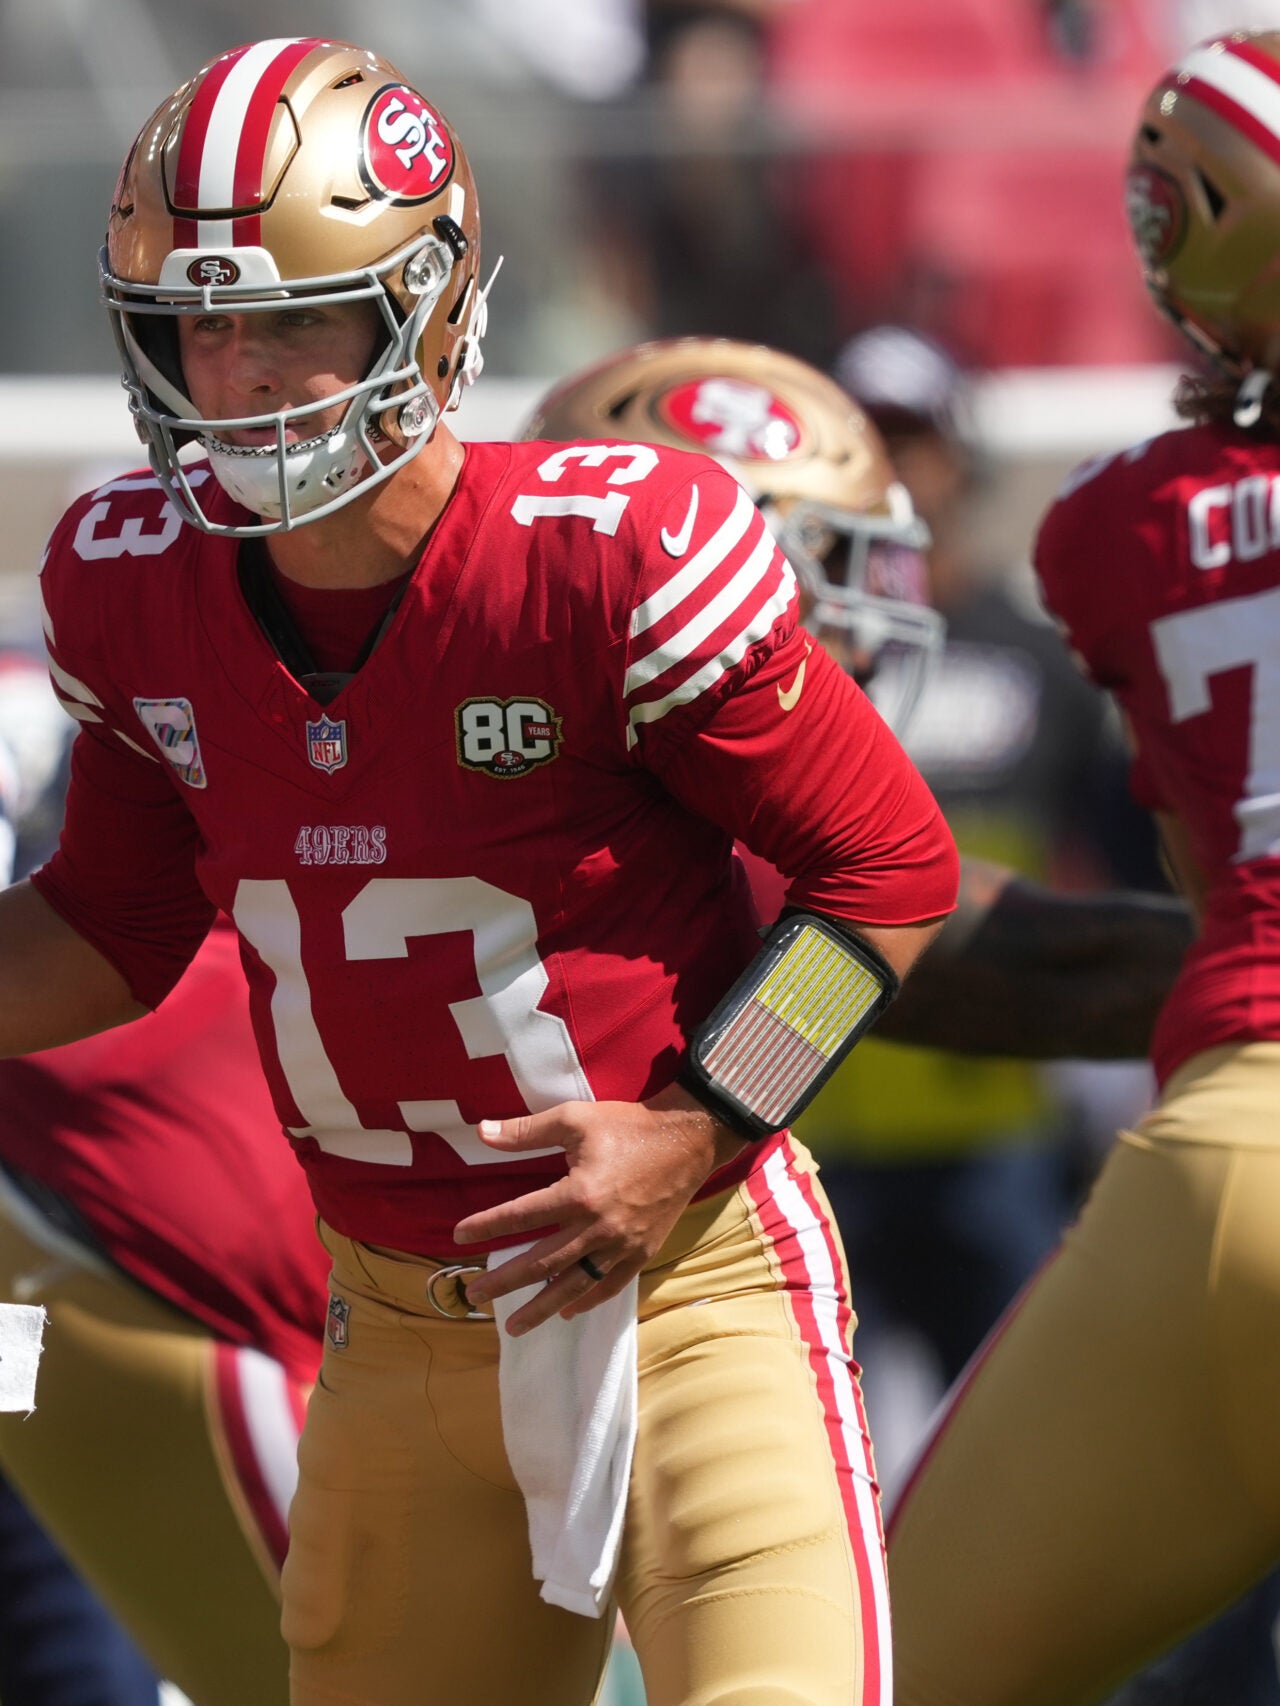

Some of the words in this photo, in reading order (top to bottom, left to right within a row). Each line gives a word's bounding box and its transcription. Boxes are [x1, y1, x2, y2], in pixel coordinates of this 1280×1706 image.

[377, 96, 448, 185] SF
[72, 469, 211, 561] 13
[509, 444, 661, 537] 13
[311, 741, 341, 764] NFL
[528, 726, 551, 737] YEARS
[294, 825, 388, 866] 49ERS
[232, 876, 596, 1166] 13
